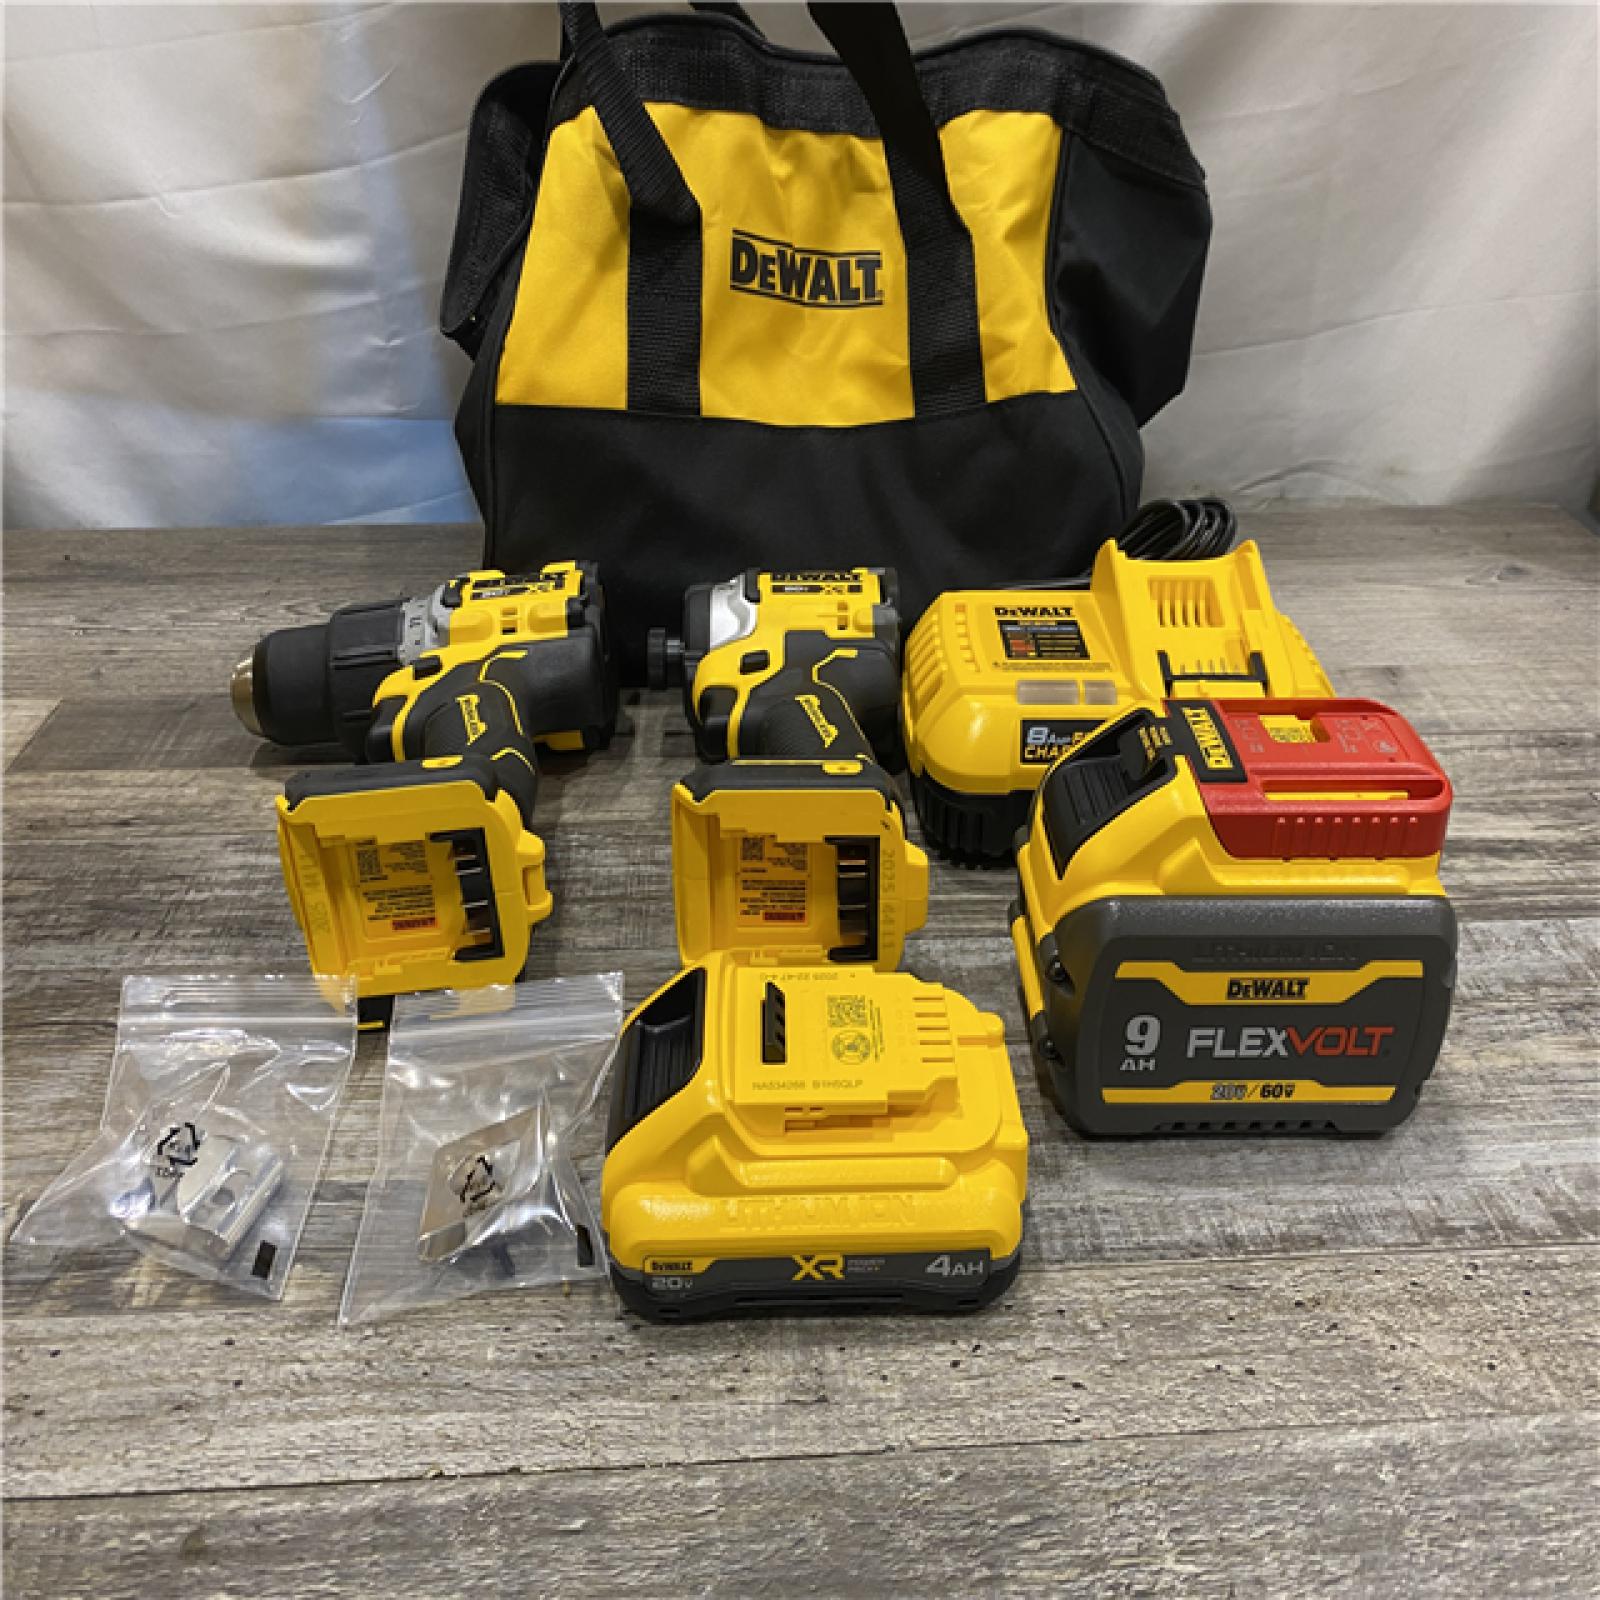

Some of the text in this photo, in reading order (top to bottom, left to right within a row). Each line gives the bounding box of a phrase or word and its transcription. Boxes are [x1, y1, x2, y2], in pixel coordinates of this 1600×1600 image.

[731, 236, 883, 304] DEWALT
[994, 606, 1074, 616] DEWALT
[1227, 977, 1309, 999] DEWALT
[1125, 1014, 1161, 1056] 9
[1185, 1026, 1395, 1058] FLEXVOLT
[1119, 1058, 1156, 1071] AH
[792, 1254, 845, 1281] XR
[925, 1254, 983, 1277] 4AH
